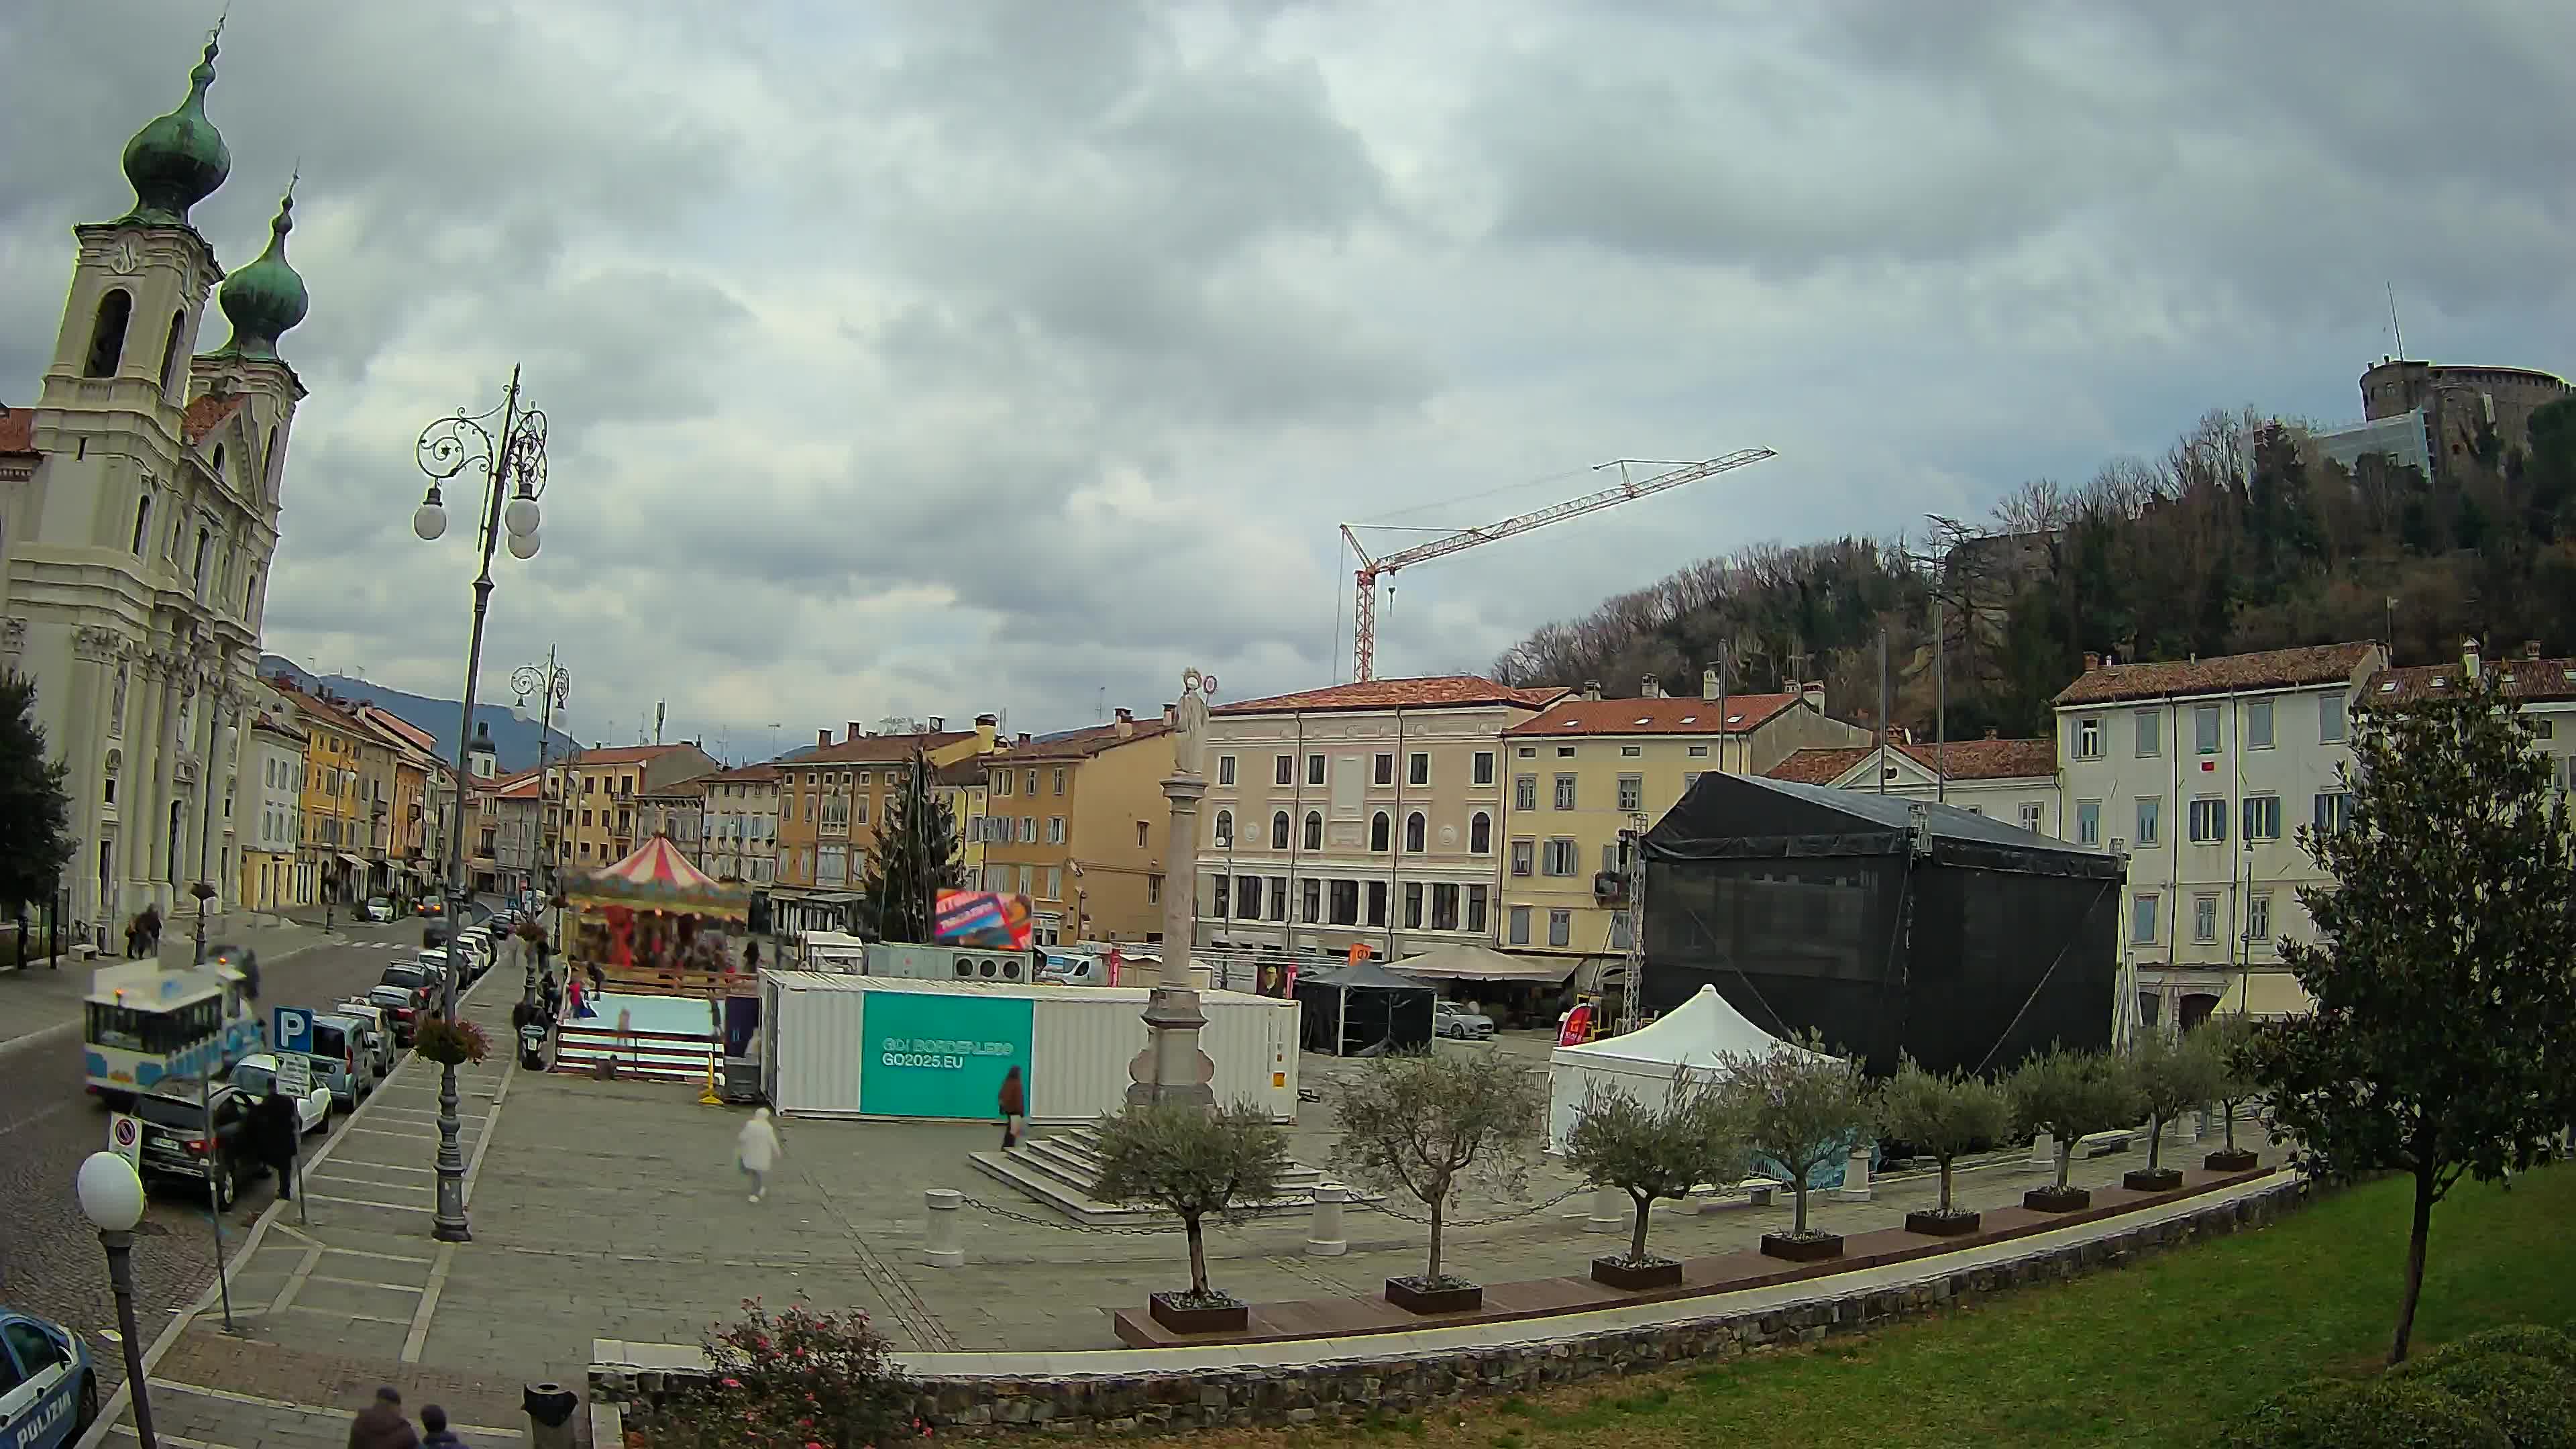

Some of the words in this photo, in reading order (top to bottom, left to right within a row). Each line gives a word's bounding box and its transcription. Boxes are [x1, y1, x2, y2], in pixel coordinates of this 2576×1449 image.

[281, 1012, 305, 1047] P
[913, 1039, 1014, 1056] BORDERLESS
[882, 1053, 964, 1069] GO2025.EU
[17, 1390, 71, 1449] POLIZIA
